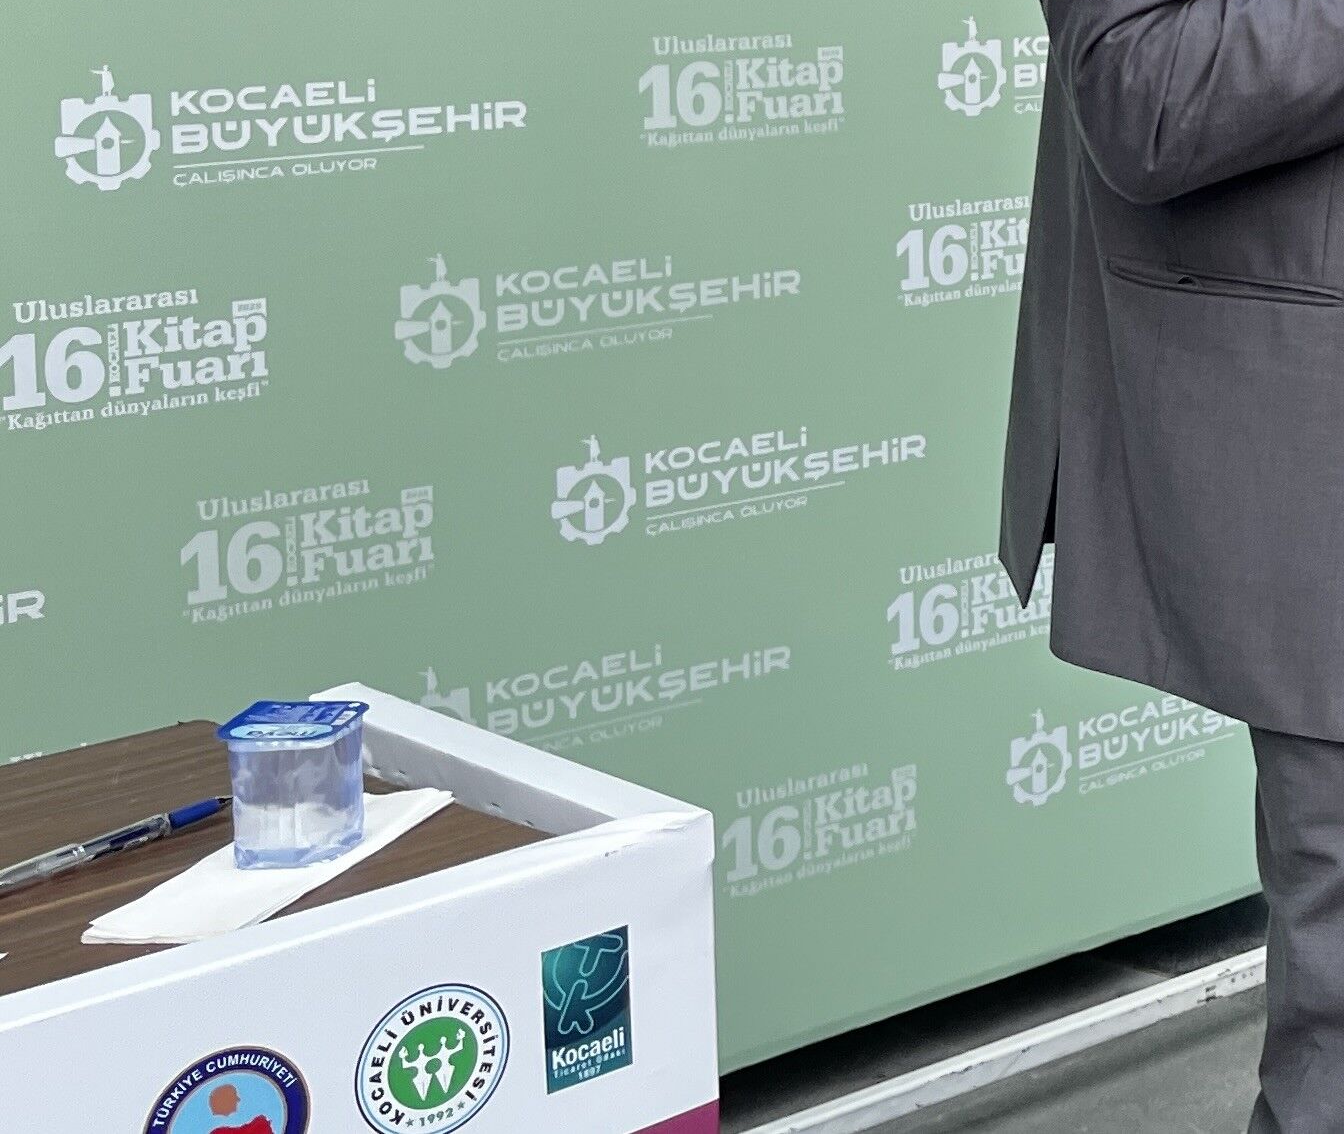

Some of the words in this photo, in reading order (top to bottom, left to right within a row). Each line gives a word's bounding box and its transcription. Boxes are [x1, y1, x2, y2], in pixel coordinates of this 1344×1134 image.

[653, 34, 793, 55] Uluslararası
[735, 57, 843, 91] Kitap
[736, 91, 845, 123] Fuarı
[980, 217, 1030, 250] Kit
[12, 289, 199, 324] Uluslararası
[122, 314, 268, 358] Kitap
[124, 350, 269, 395] Fuarı
[196, 479, 370, 521] Uluslararası
[300, 502, 433, 548] Kitap
[301, 536, 434, 584] Fuarı
[971, 598, 1051, 635] Fuar
[815, 778, 917, 827] Kitap
[815, 807, 917, 857] Fuarı
[369, 1028, 406, 1126] KOCAELİ
[401, 996, 499, 1101] ÜNİVERSİTESİ
[552, 1026, 625, 1071] Kocaeli
[152, 1069, 203, 1128] TÜRKİYE
[205, 1053, 297, 1088] CUMHURİYETİ
[419, 1108, 454, 1127] 1992
